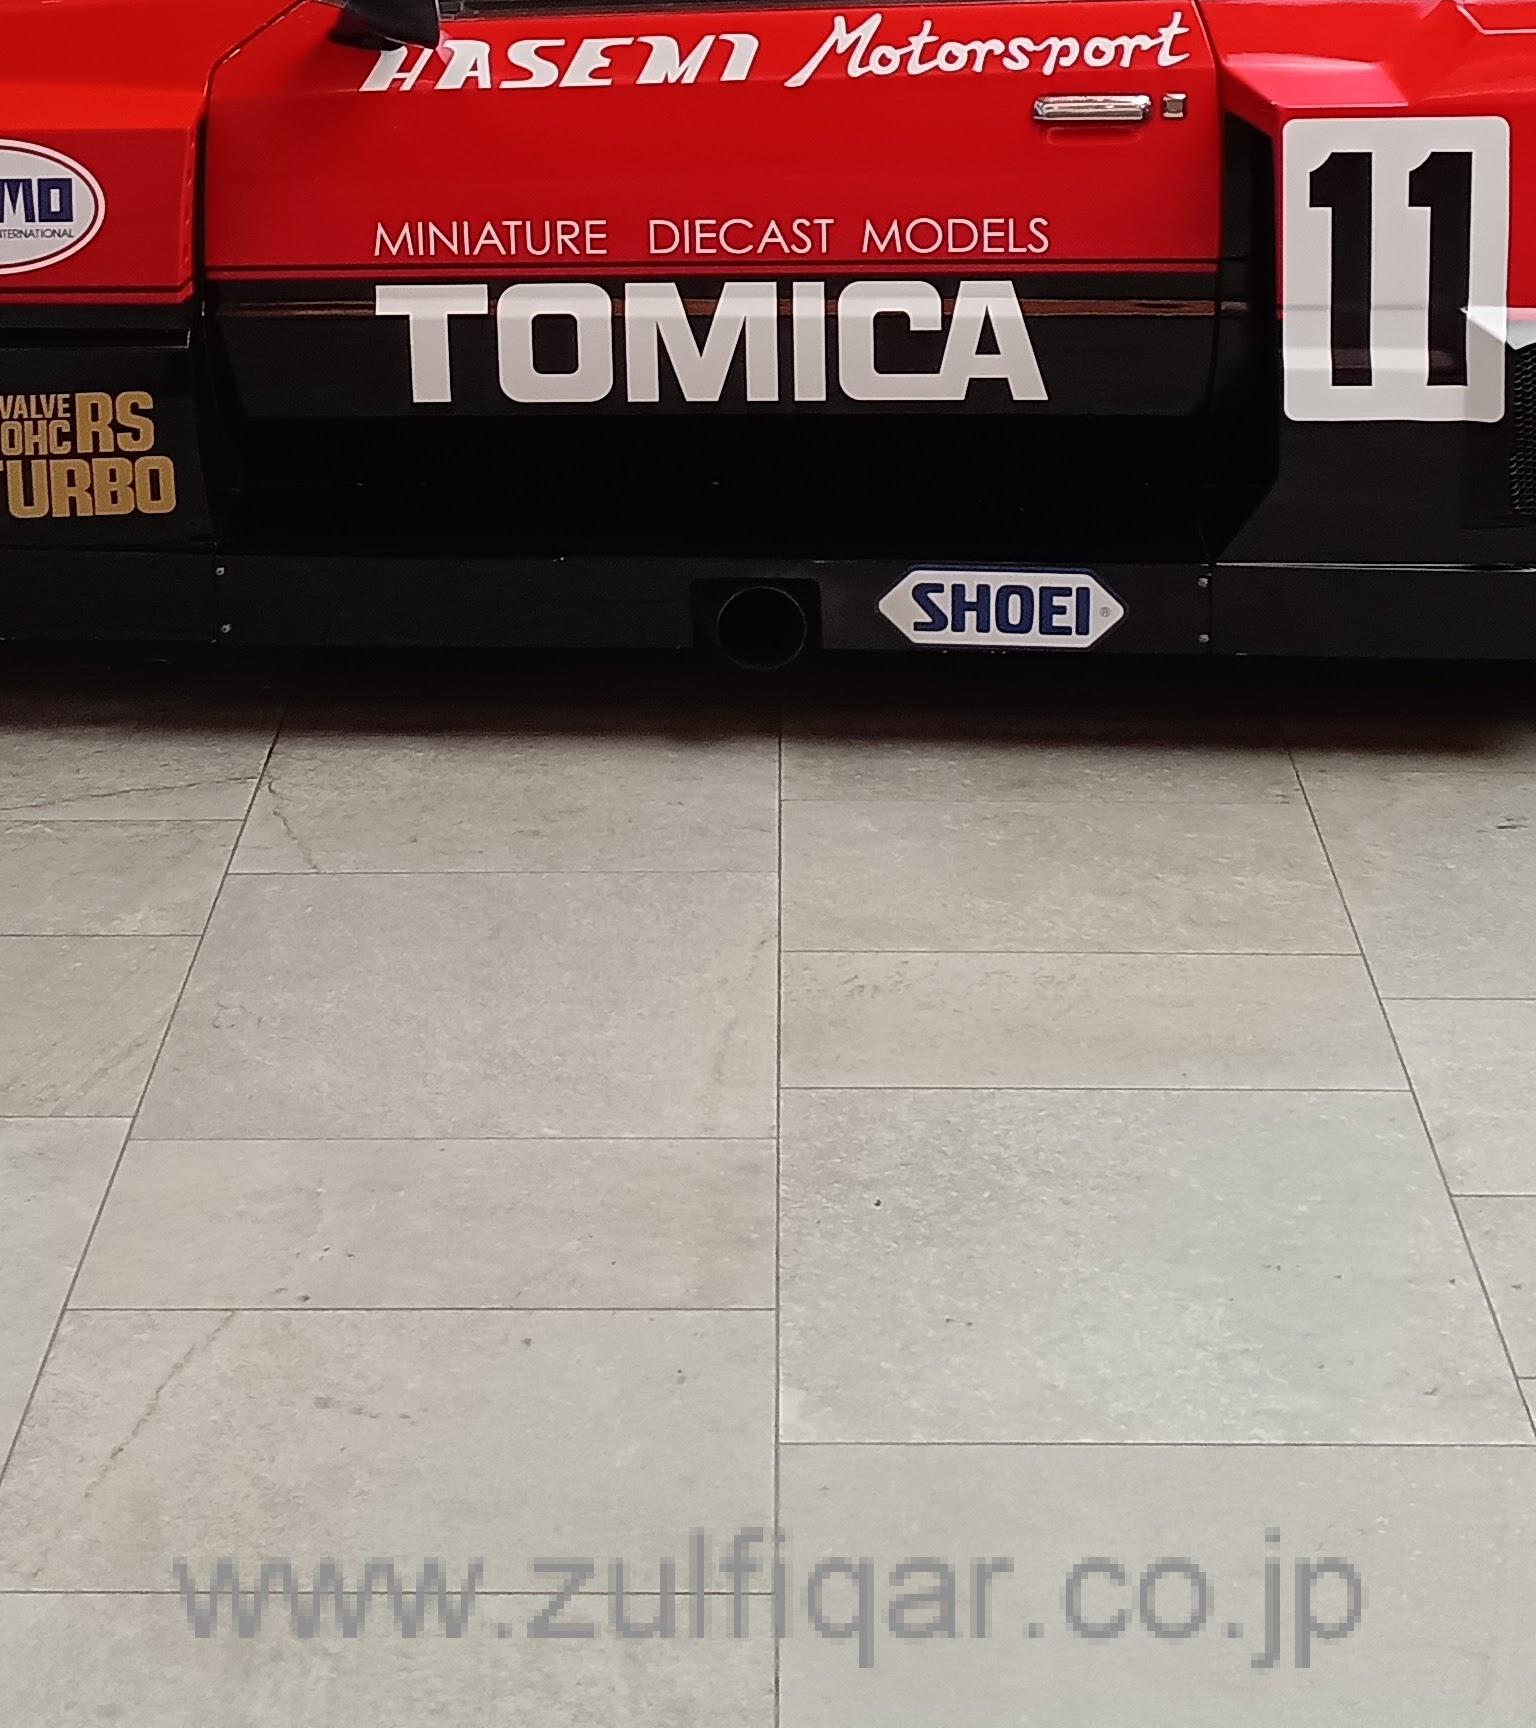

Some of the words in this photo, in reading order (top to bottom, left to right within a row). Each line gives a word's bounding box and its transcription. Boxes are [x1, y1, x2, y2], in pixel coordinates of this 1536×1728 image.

[784, 11, 1190, 88] Motorsport
[373, 220, 607, 256] MINIATURE
[649, 218, 834, 254] DIECAST
[862, 217, 1050, 253] MODELS
[1309, 151, 1473, 387] 11
[375, 280, 1049, 403] TOMICA
[75, 390, 155, 454] RS
[911, 582, 1091, 636] SHOEI
